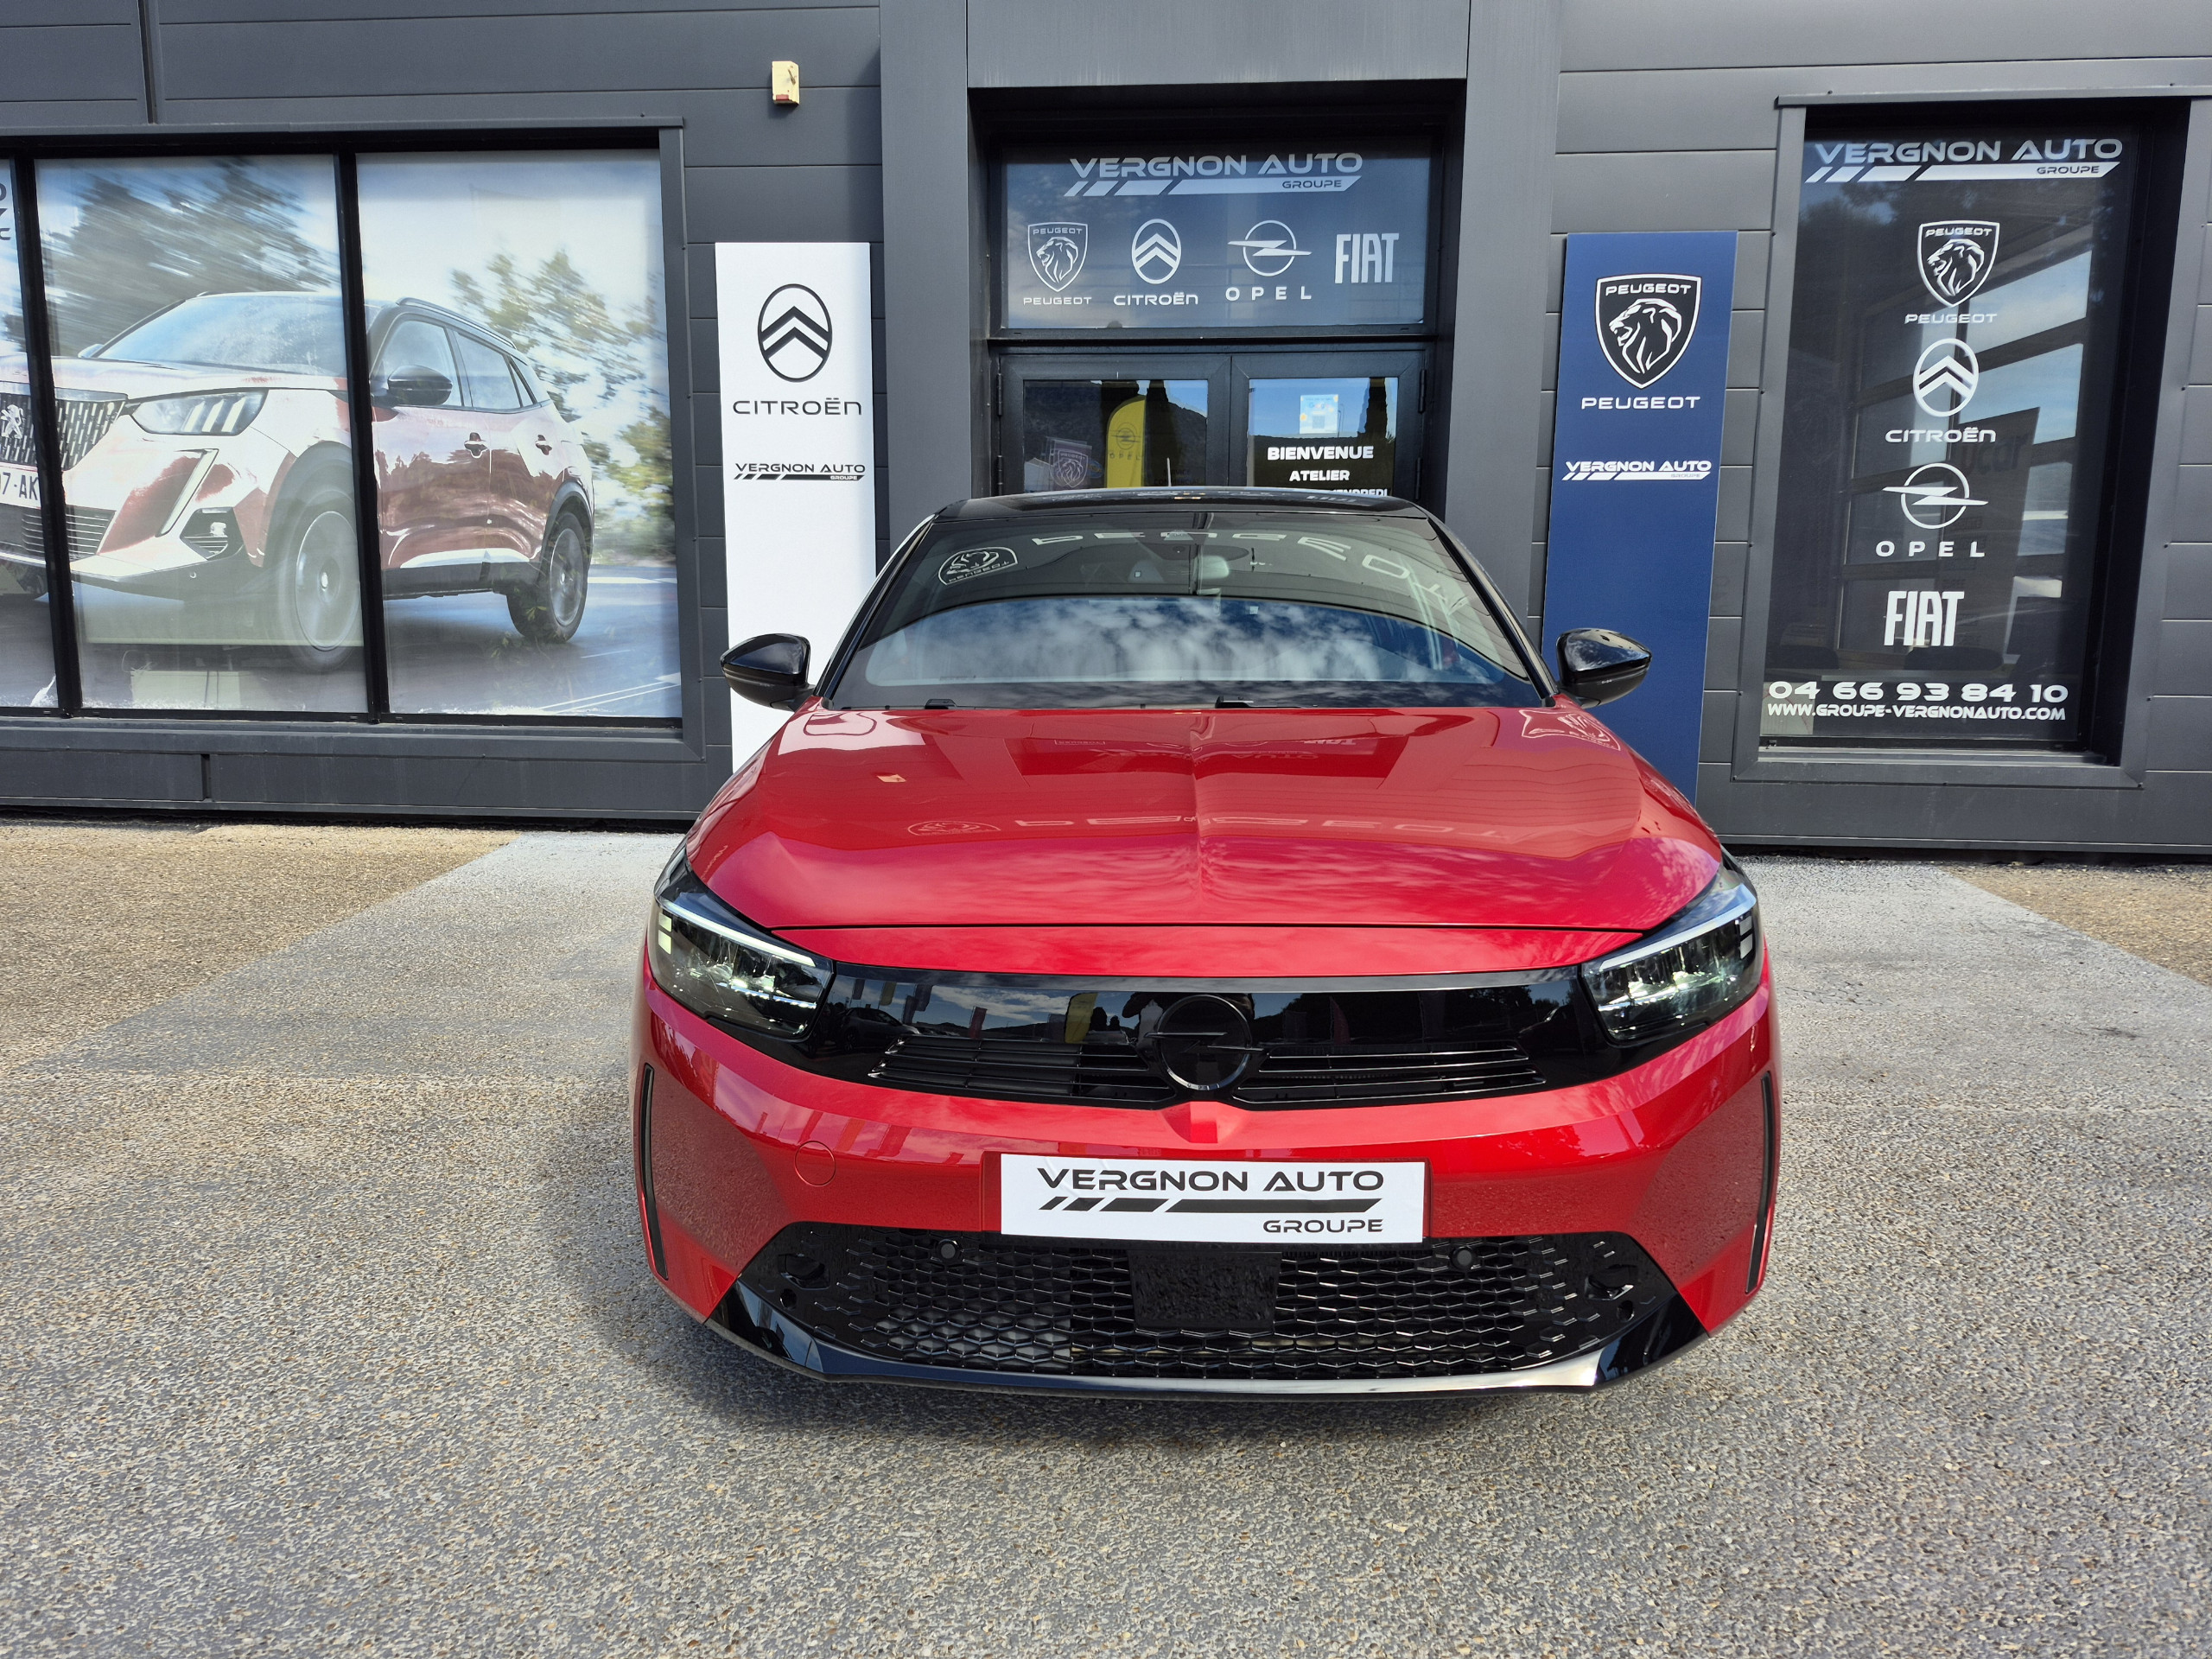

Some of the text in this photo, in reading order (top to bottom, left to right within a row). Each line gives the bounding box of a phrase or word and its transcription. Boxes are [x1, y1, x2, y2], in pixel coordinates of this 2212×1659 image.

[1815, 139, 2123, 164] VERGNON AUTO
[1070, 153, 1363, 178] VERGNON AUTO
[2037, 165, 2100, 175] GROUPE
[1281, 180, 1342, 189] GROUPE
[1033, 226, 1083, 236] PEUGEOT
[1925, 227, 1993, 238] PEUGEOT
[1335, 233, 1399, 284] FIAT
[1225, 286, 1312, 301] OPEL
[1605, 283, 1692, 296] PEUGEOT
[1023, 296, 1092, 306] PEUGEOT
[1113, 292, 1198, 306] CITROËN
[1904, 313, 1998, 325] PEUGEOT
[733, 397, 862, 416] CITROËN
[1581, 396, 1700, 410] PEUGEOT
[1885, 427, 1997, 443] CITROËN
[1267, 446, 1374, 461] BIENVENUE
[735, 463, 866, 474] VERGNON AUTO
[1565, 460, 1712, 473] VERGNON AUTO
[1289, 470, 1350, 481] ATELIER
[0, 471, 38, 500] 7-AK
[1333, 489, 1388, 498] REDI
[1876, 541, 1986, 557] OPEL
[1884, 591, 1965, 646] FIAT
[1768, 681, 2069, 702] 04 66 93 84 10
[1767, 703, 2066, 721] WWW.GROUPE-VERGNONAUTO.COM
[1037, 1167, 1383, 1192] VERGNON AUTO
[1262, 1218, 1383, 1234] GROUPE
